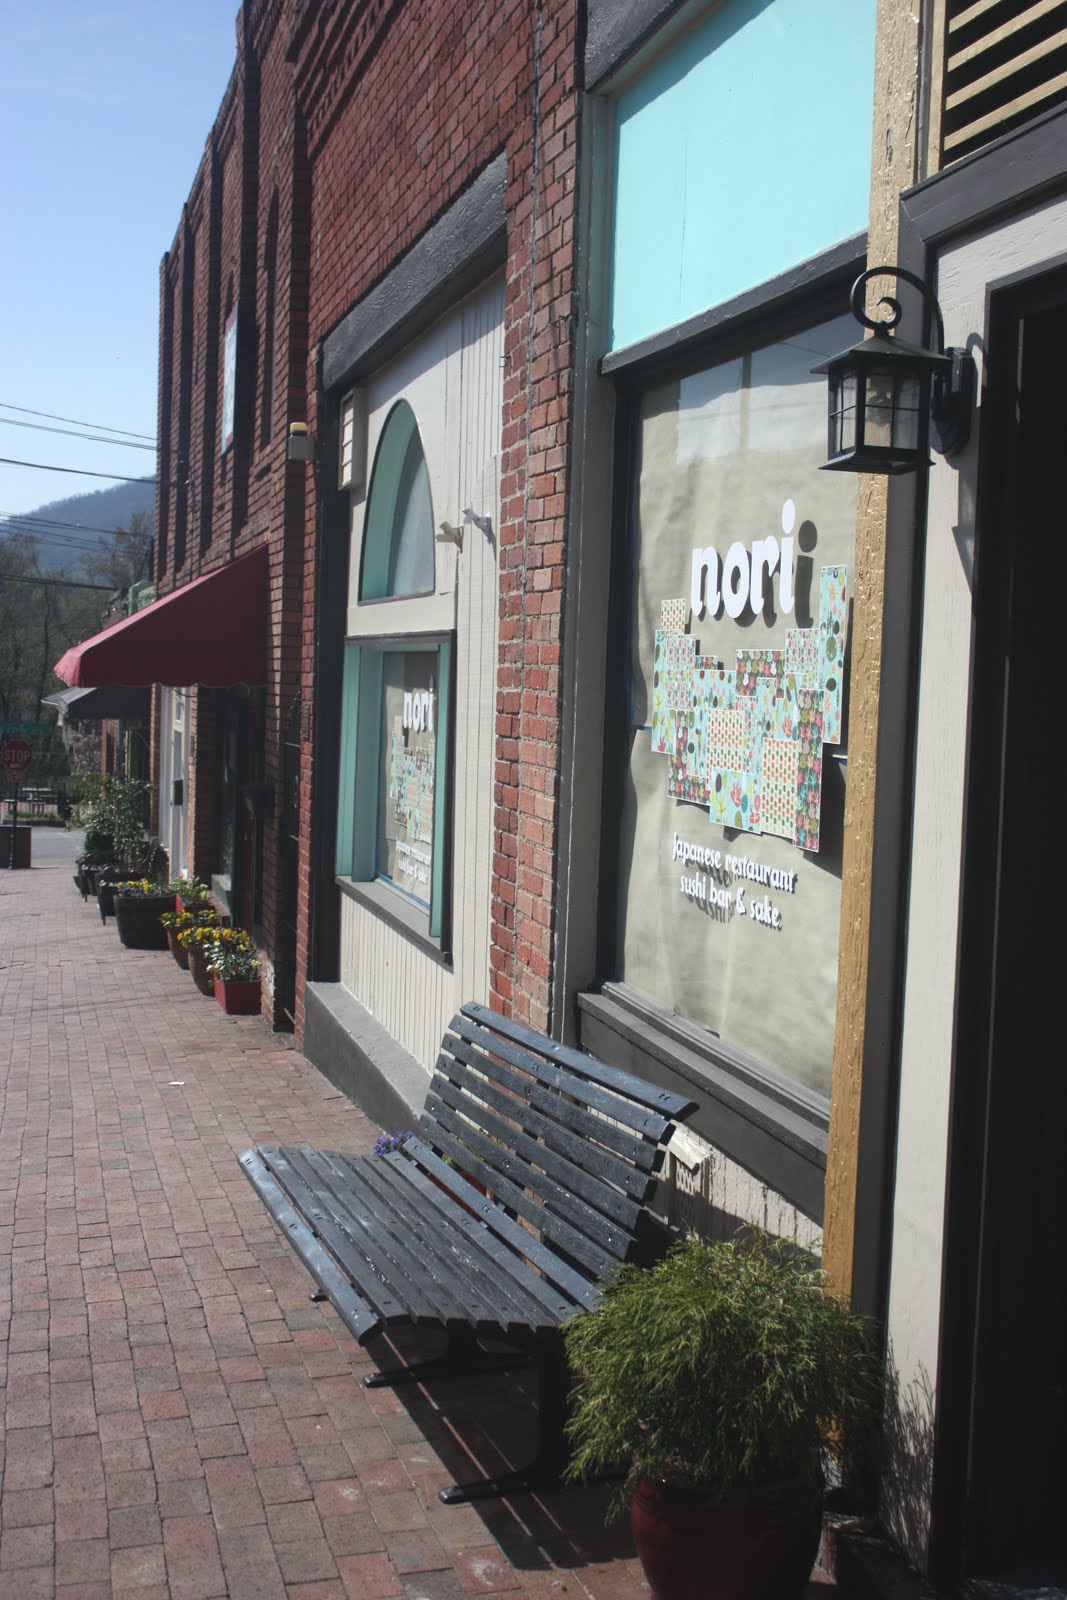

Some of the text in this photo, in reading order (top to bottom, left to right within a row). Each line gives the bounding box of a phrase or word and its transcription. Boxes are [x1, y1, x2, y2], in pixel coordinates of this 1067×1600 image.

[690, 498, 796, 619] nori
[403, 673, 434, 732] nori
[4, 750, 31, 762] STOP
[680, 872, 781, 927] sushi bar & sake
[725, 853, 795, 893] restaurant
